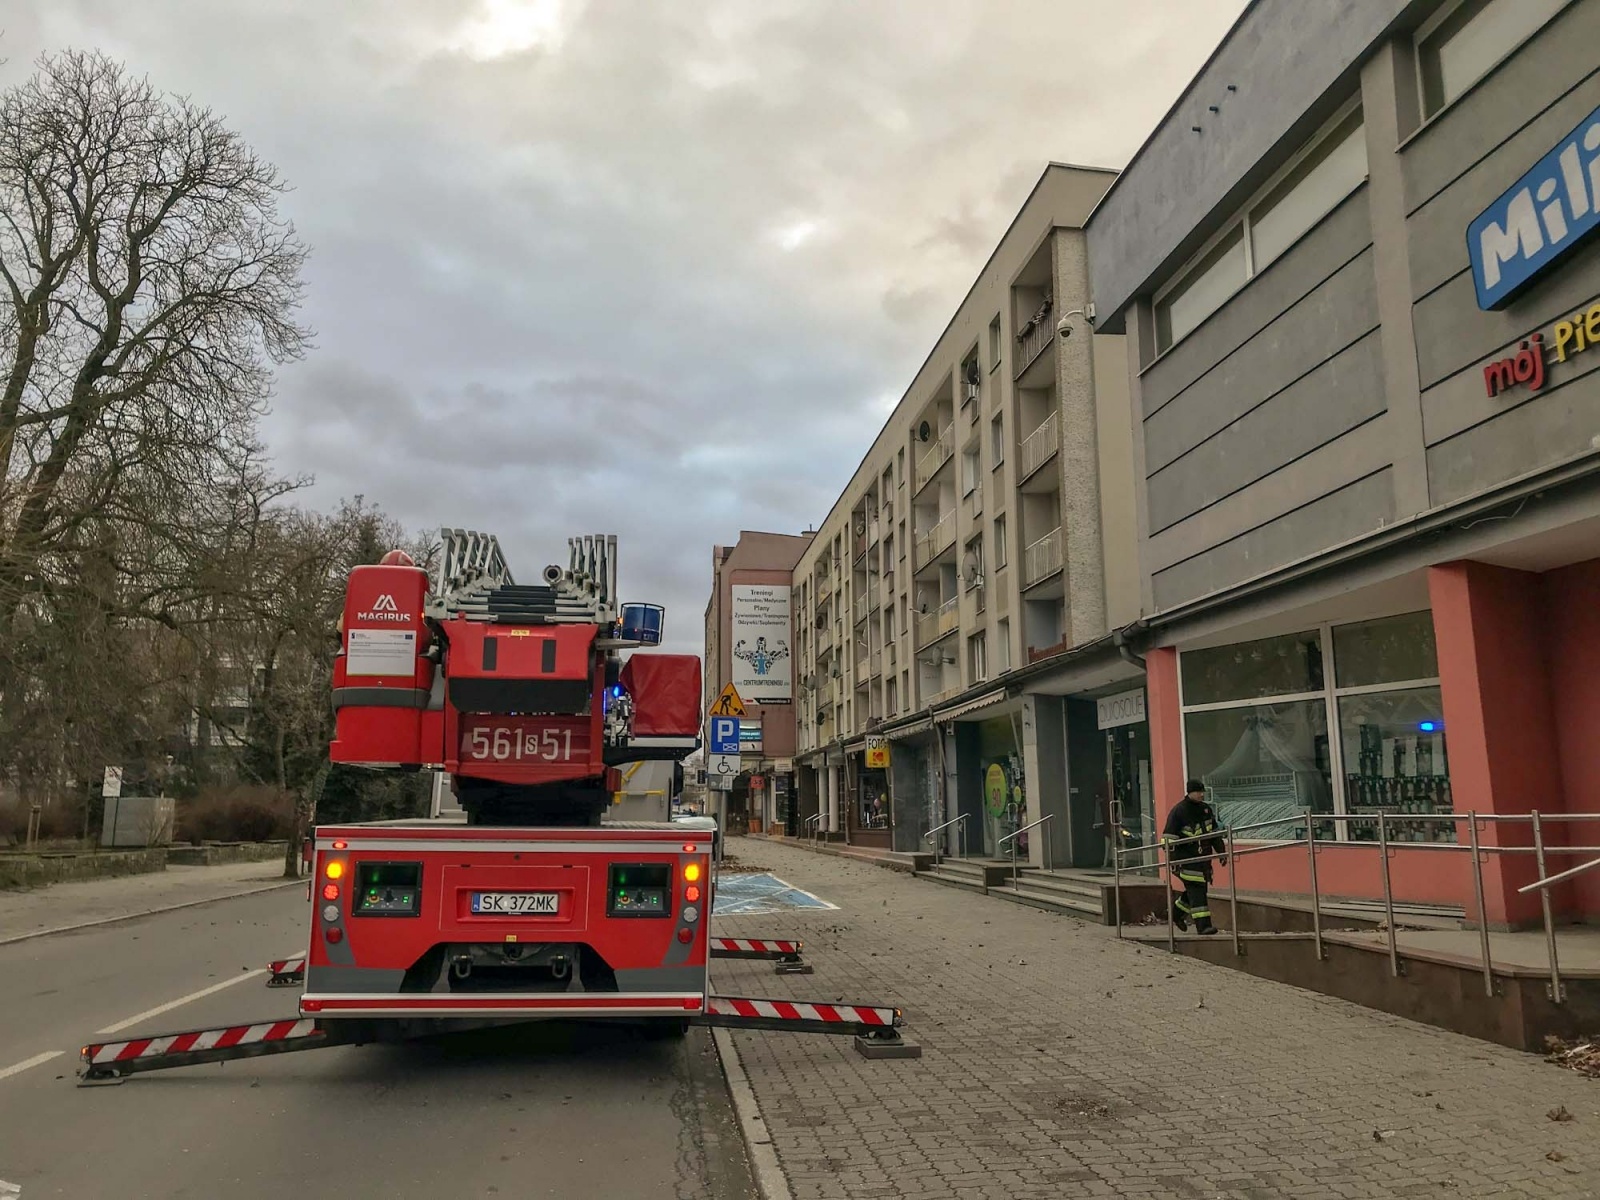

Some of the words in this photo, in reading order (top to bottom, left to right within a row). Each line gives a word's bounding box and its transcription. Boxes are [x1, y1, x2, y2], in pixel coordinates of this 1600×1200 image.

[1484, 332, 1544, 397] mój
[750, 589, 774, 597] Treningi
[357, 612, 411, 622] MAGIRUS
[717, 719, 734, 743] P
[482, 895, 504, 910] SK
[509, 895, 555, 911] 372MK
